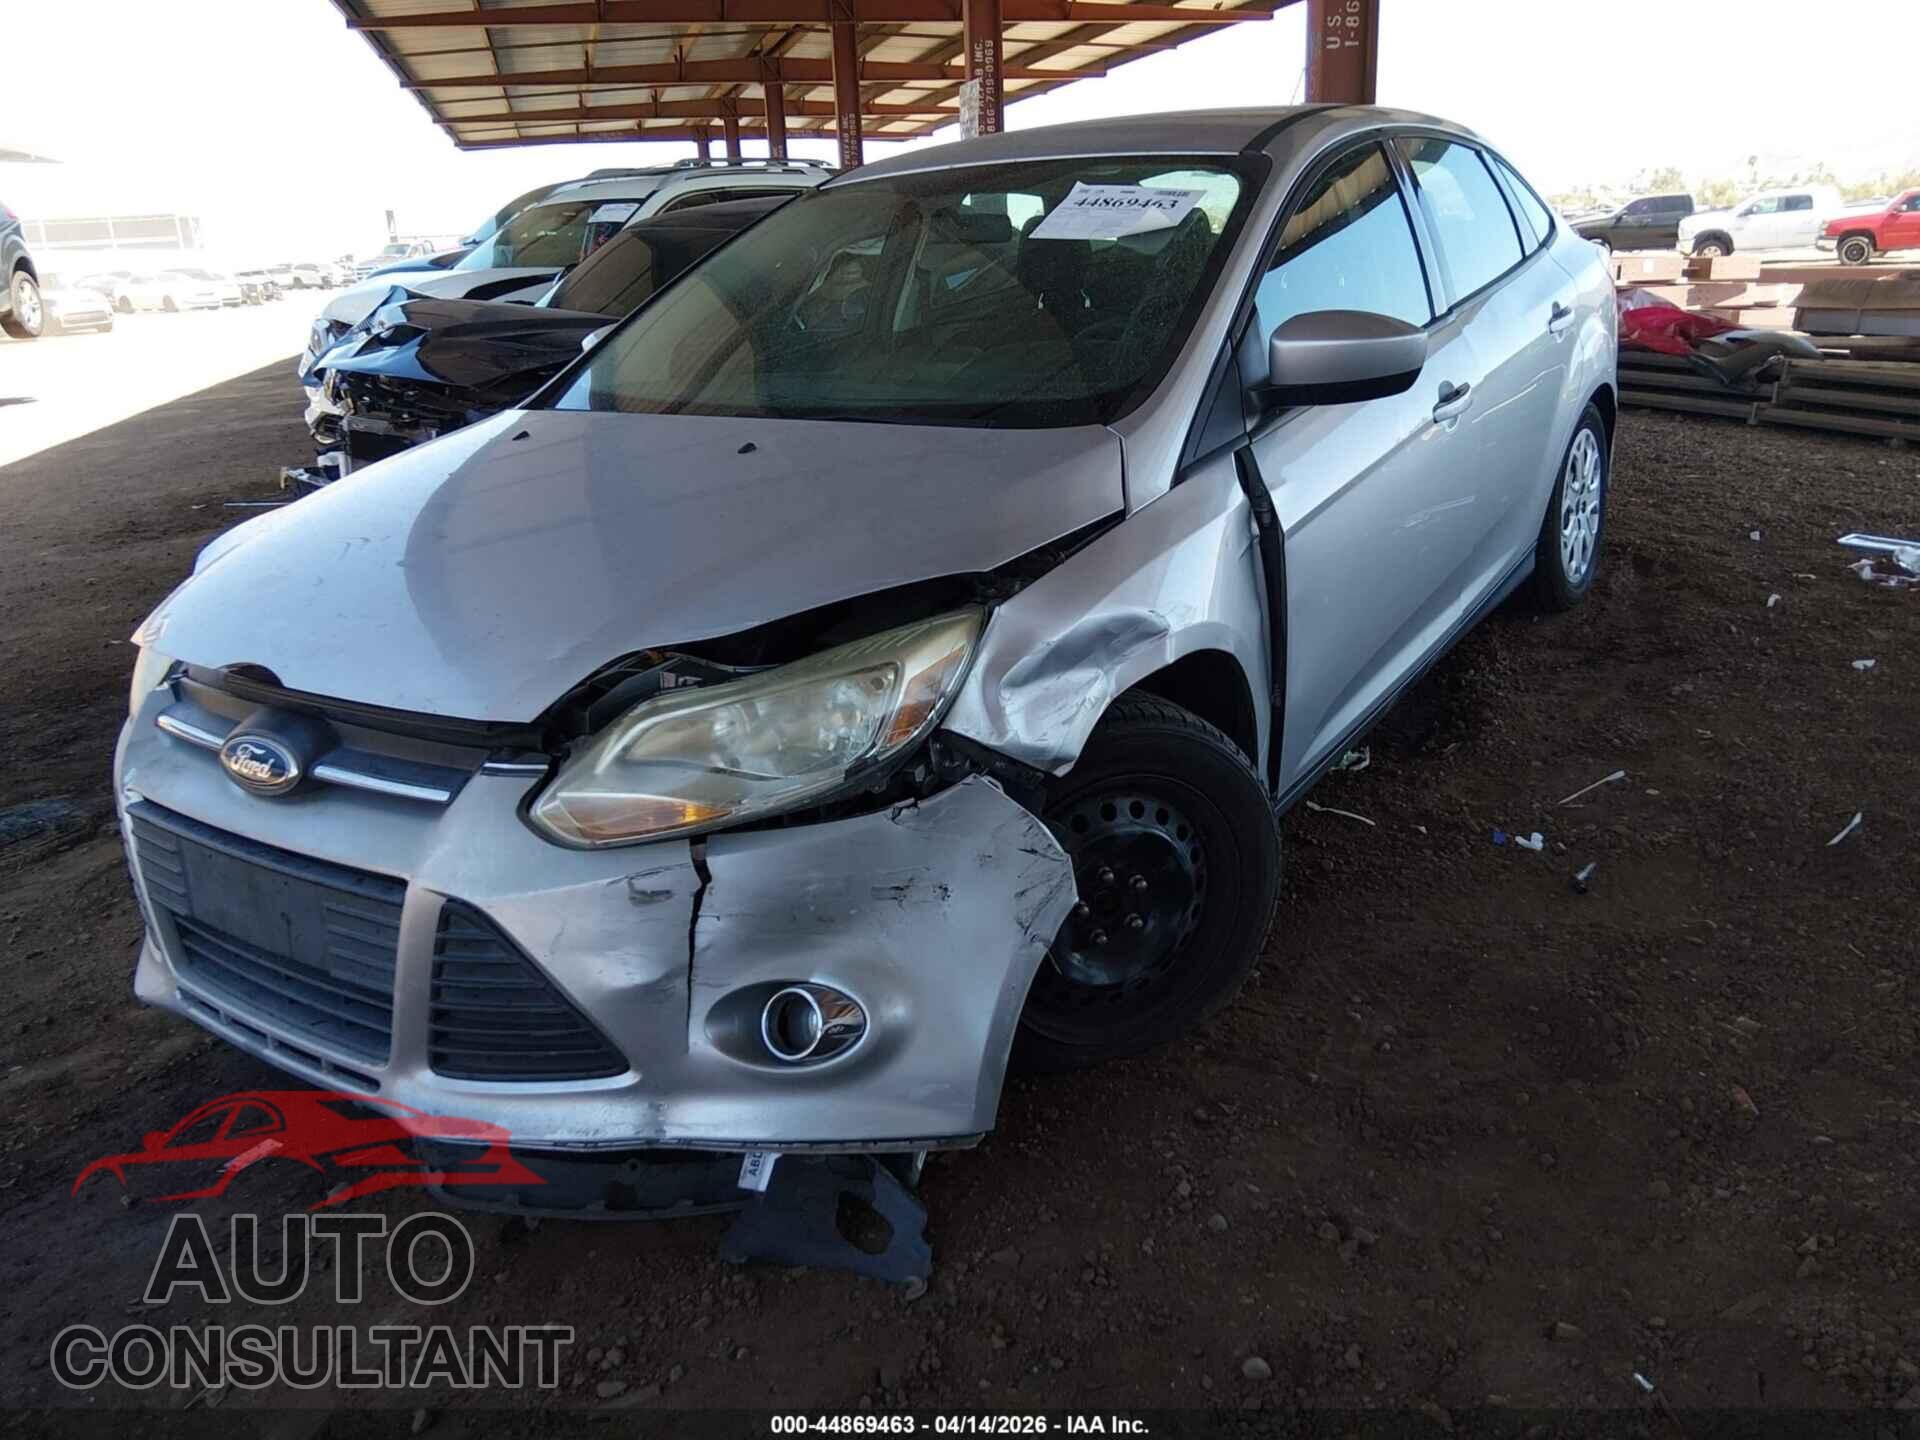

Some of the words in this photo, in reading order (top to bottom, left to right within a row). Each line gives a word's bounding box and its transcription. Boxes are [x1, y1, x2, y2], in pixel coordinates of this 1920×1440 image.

[1326, 8, 1342, 49] U.S.
[1344, 0, 1360, 46] 1-86
[974, 39, 984, 63] INC.
[1073, 197, 1179, 210] 44869463
[230, 743, 275, 778] Ford
